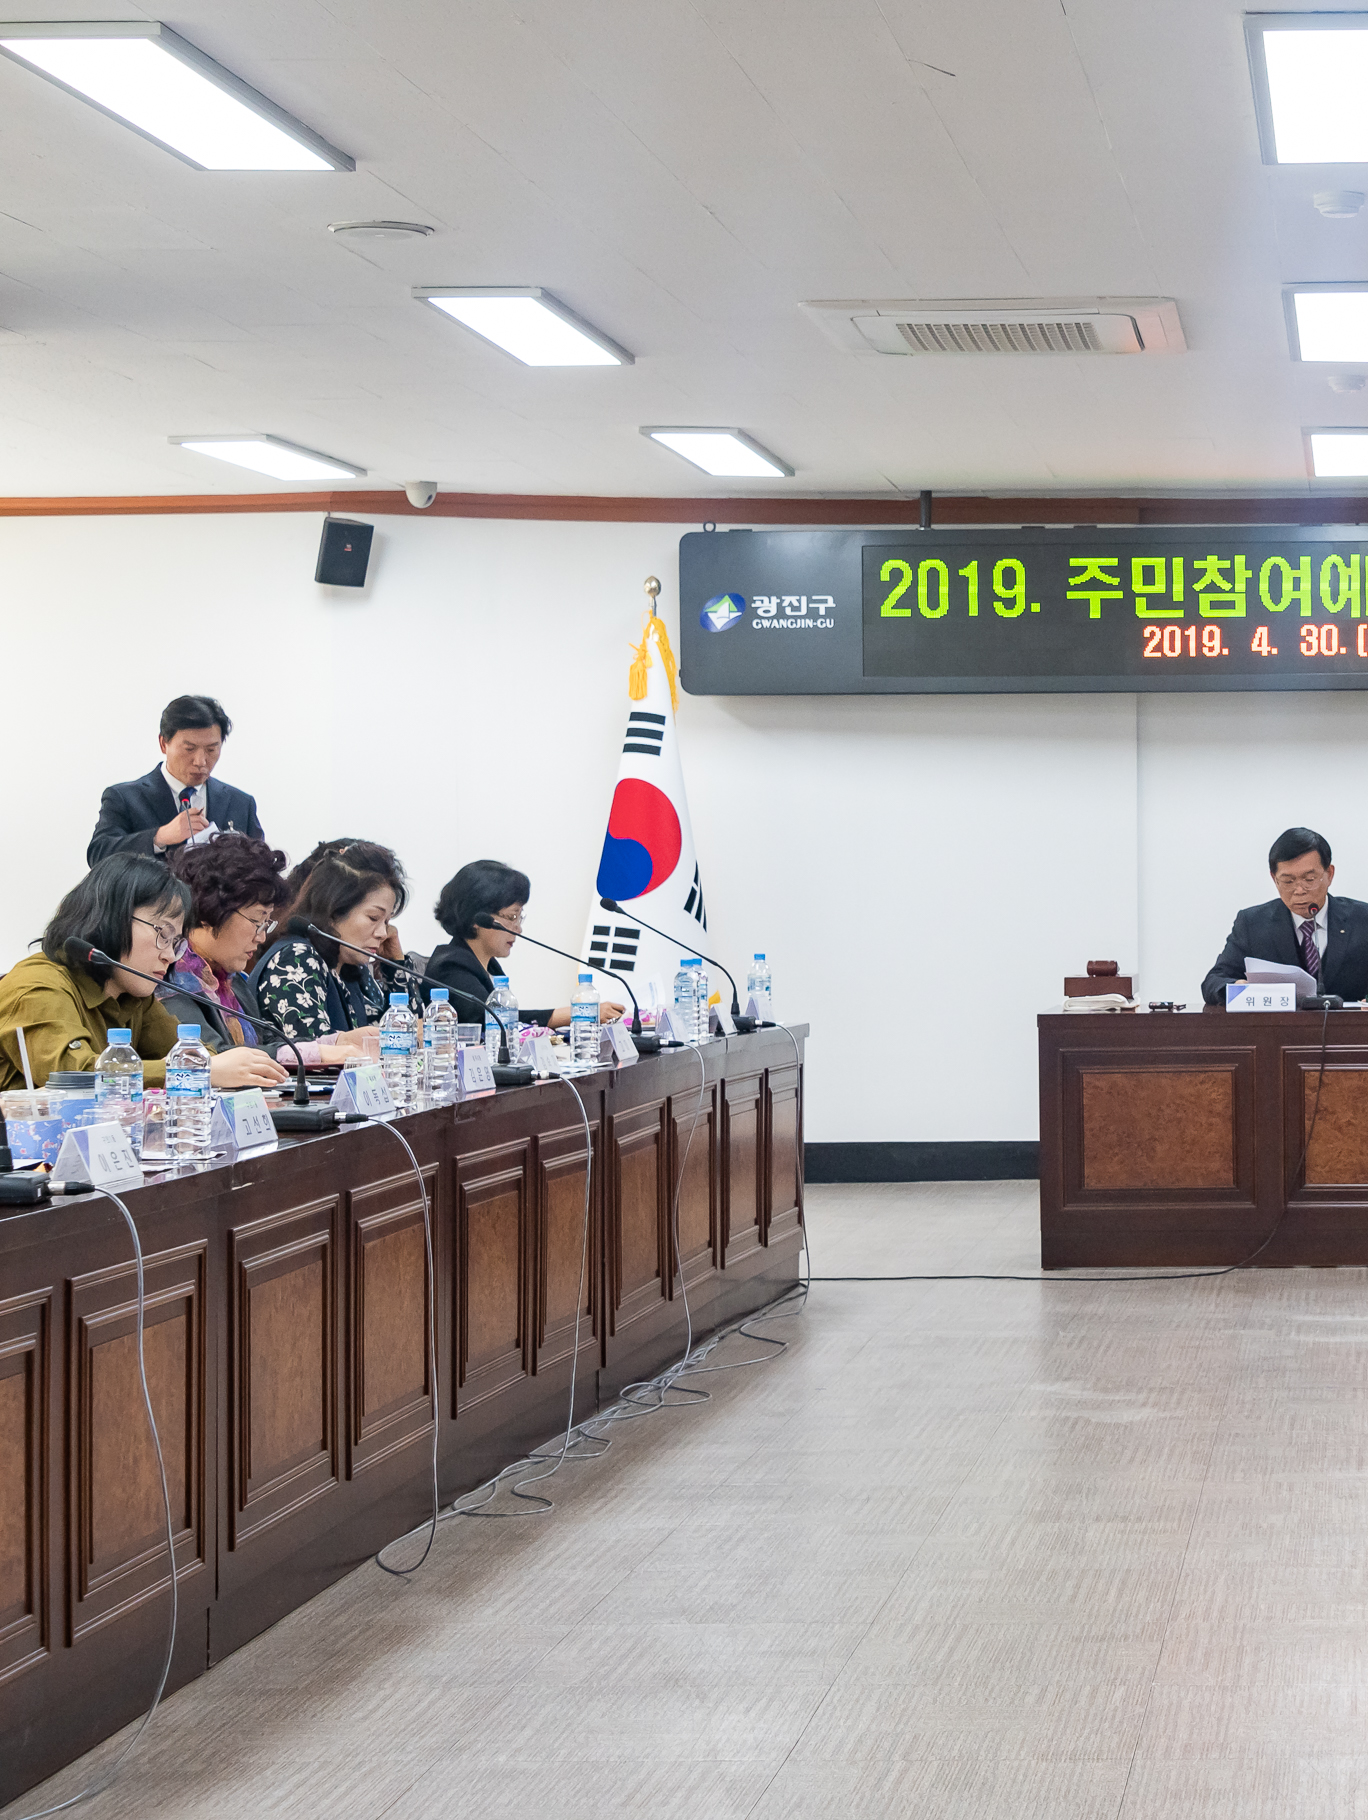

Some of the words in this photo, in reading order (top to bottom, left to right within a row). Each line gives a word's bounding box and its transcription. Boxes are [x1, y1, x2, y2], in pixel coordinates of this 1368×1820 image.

[879, 558, 1041, 619] 2019.
[751, 595, 836, 617] 광진구
[752, 618, 834, 629] GWANGJIN-GU
[1143, 624, 1230, 658] 2019.
[1250, 625, 1279, 657] 4.
